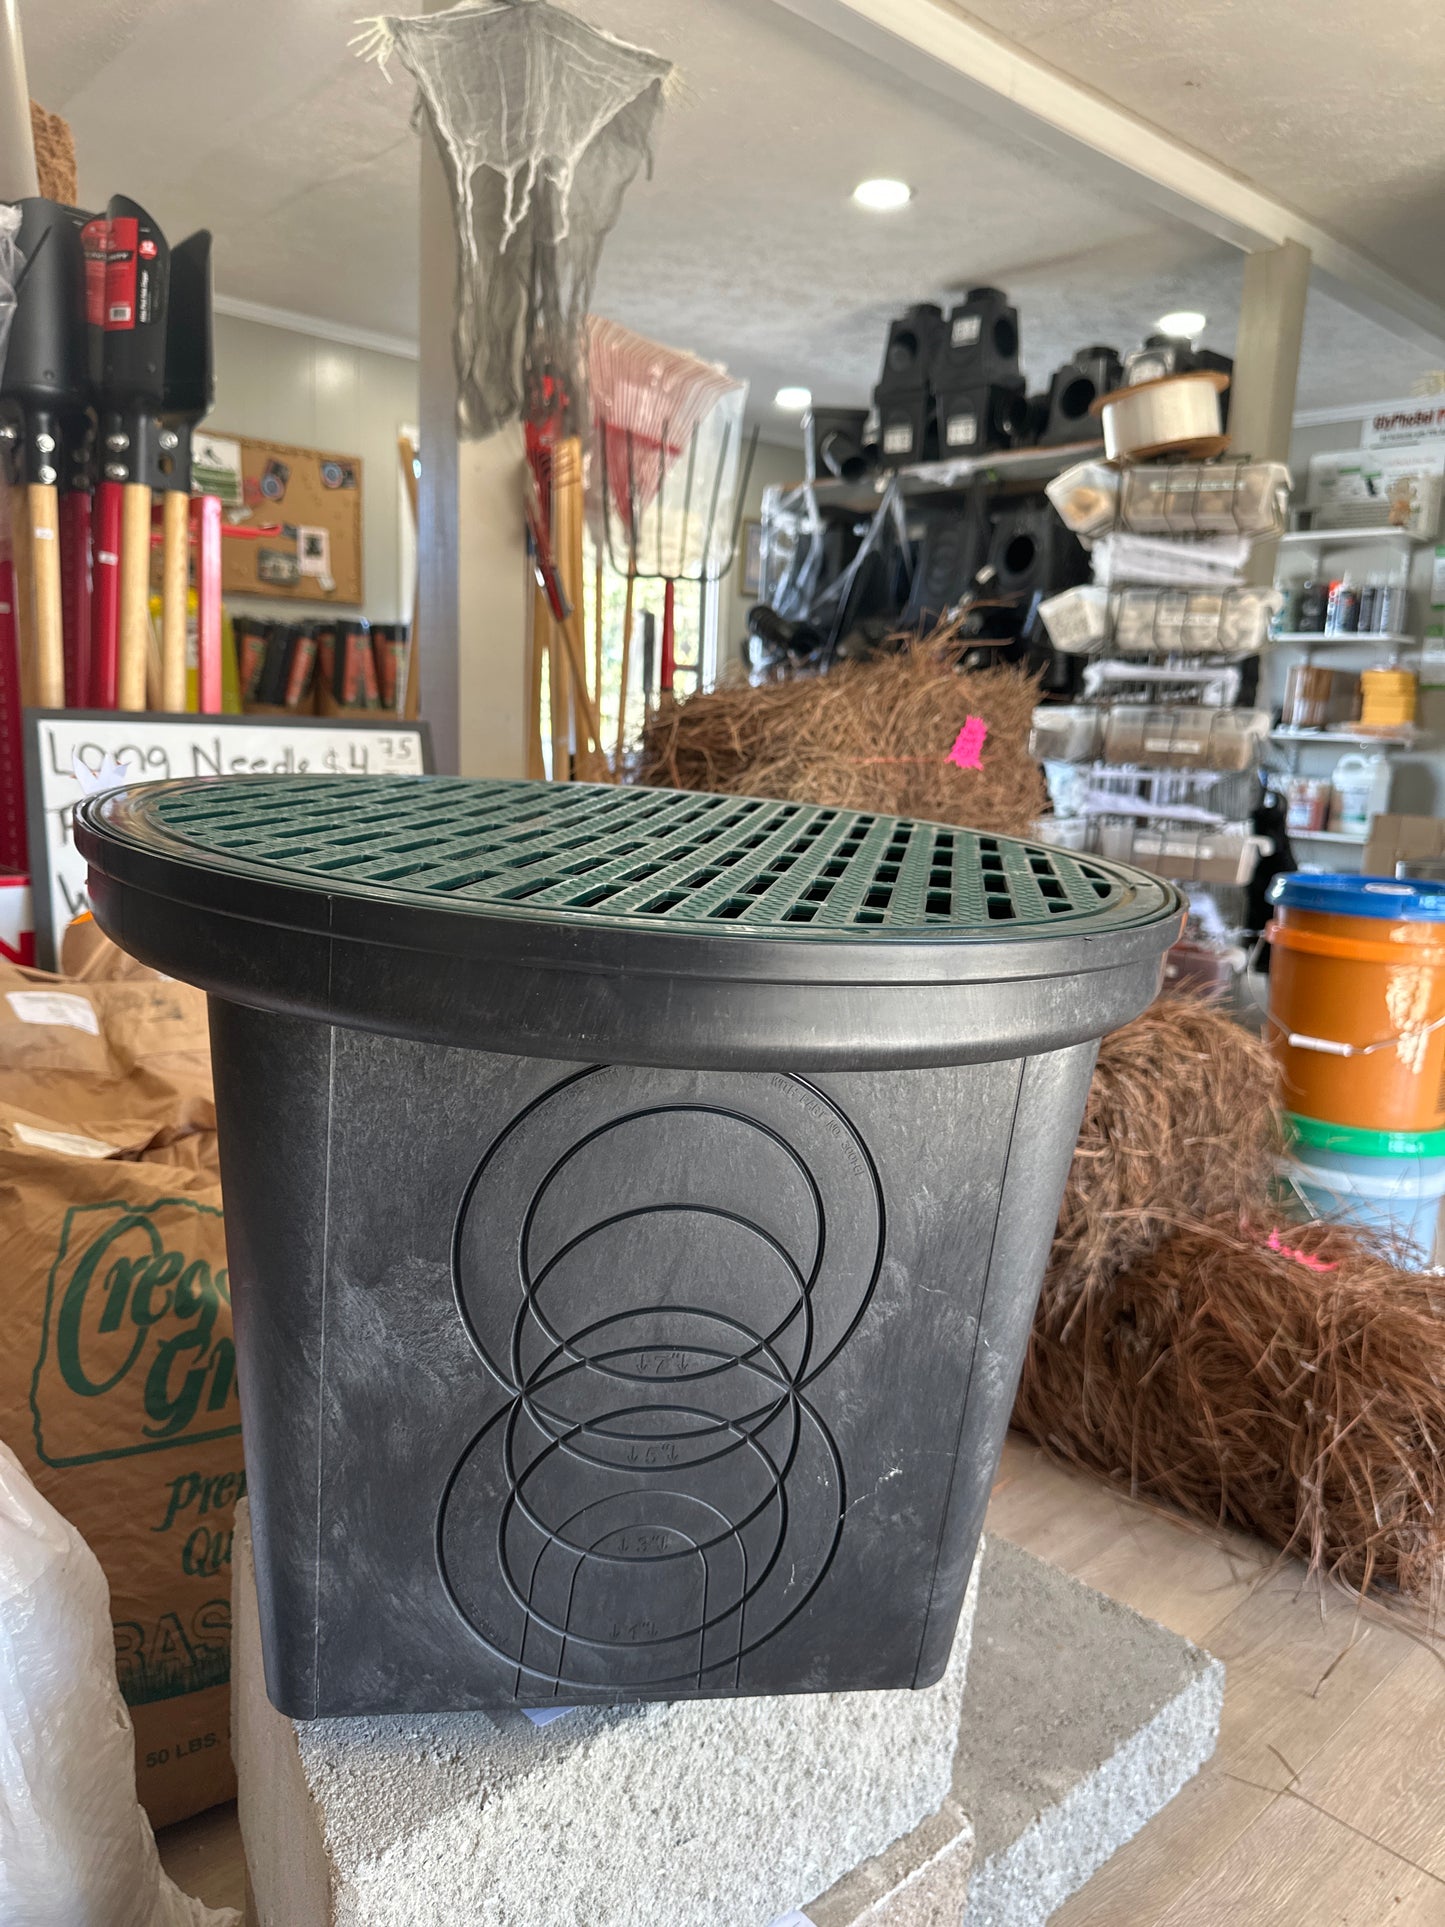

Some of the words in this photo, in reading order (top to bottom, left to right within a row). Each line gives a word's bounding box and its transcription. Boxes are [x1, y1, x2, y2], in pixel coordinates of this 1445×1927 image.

[48, 728, 170, 779] Long
[800, 1094, 825, 1118] PART
[145, 1749, 169, 1768] 50
